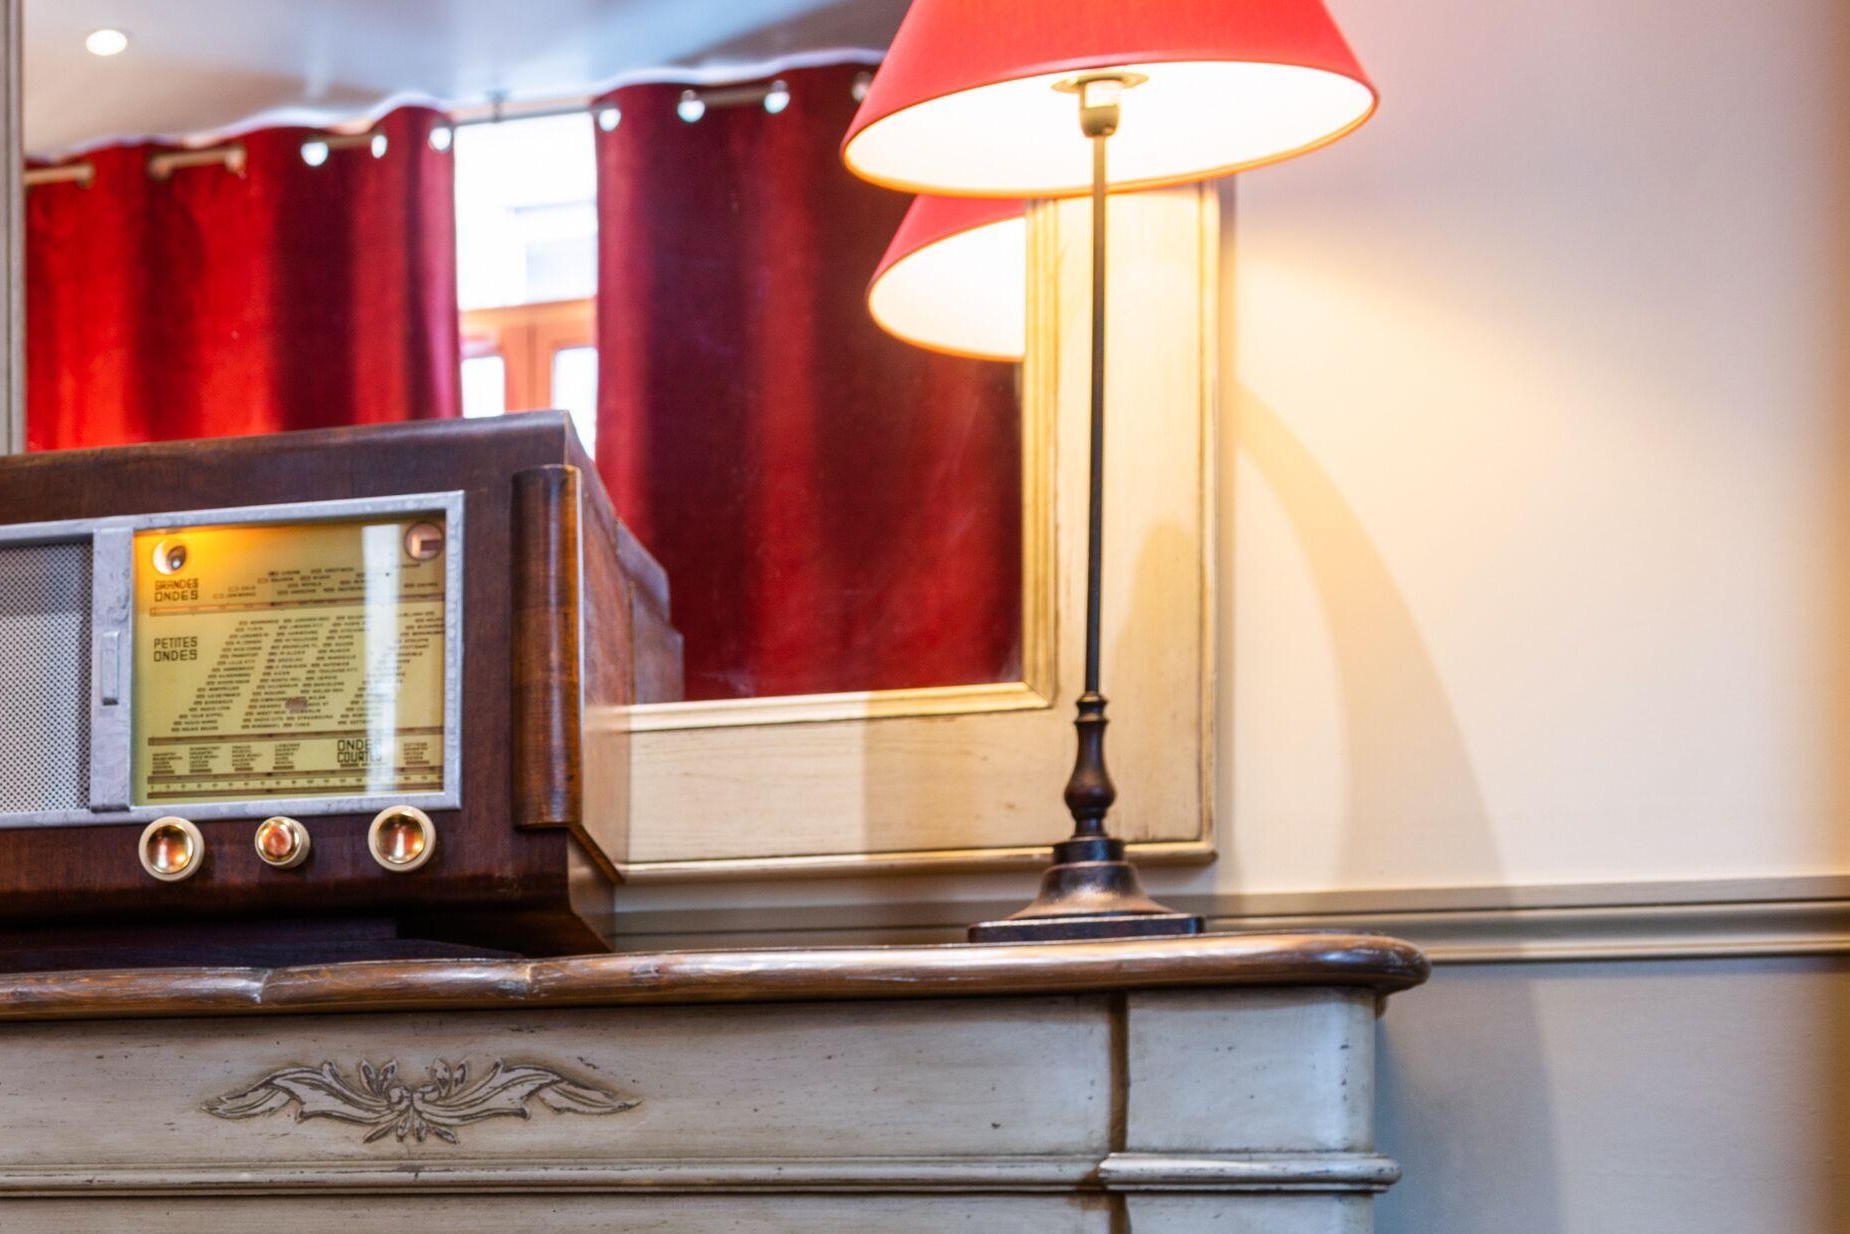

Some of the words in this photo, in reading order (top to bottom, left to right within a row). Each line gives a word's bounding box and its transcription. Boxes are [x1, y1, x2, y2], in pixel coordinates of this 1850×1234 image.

[154, 578, 199, 591] GRANDES
[154, 589, 199, 602] ONDES
[153, 636, 198, 649] PETITES
[153, 649, 198, 662] ONDES
